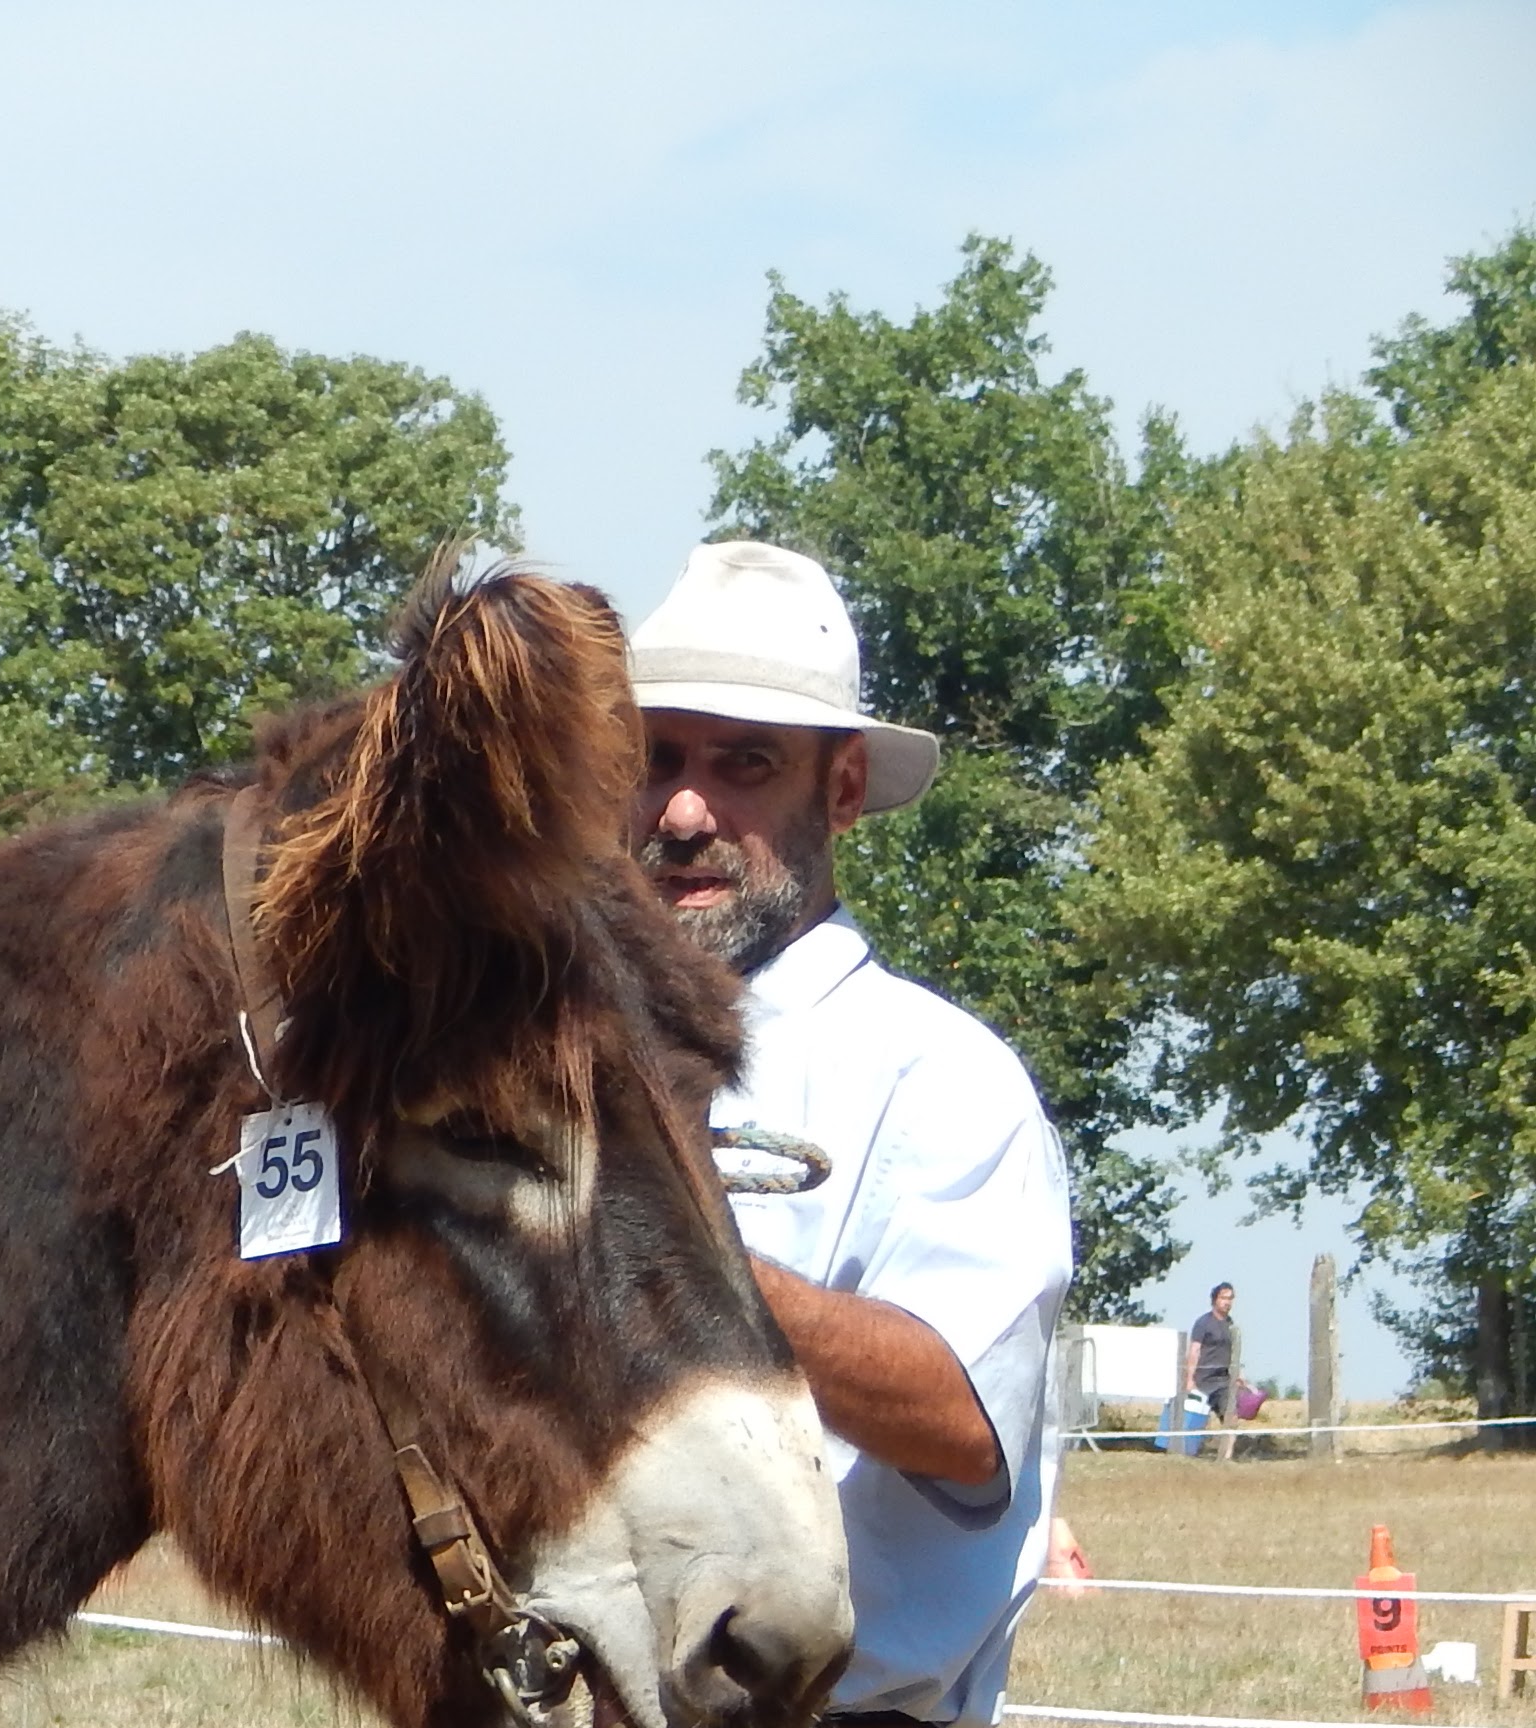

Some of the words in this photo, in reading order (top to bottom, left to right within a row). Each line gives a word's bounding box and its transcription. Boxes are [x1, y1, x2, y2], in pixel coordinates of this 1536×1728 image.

[256, 1129, 323, 1199] 55
[1372, 1595, 1401, 1632] 9
[1370, 1644, 1408, 1654] POINTS
